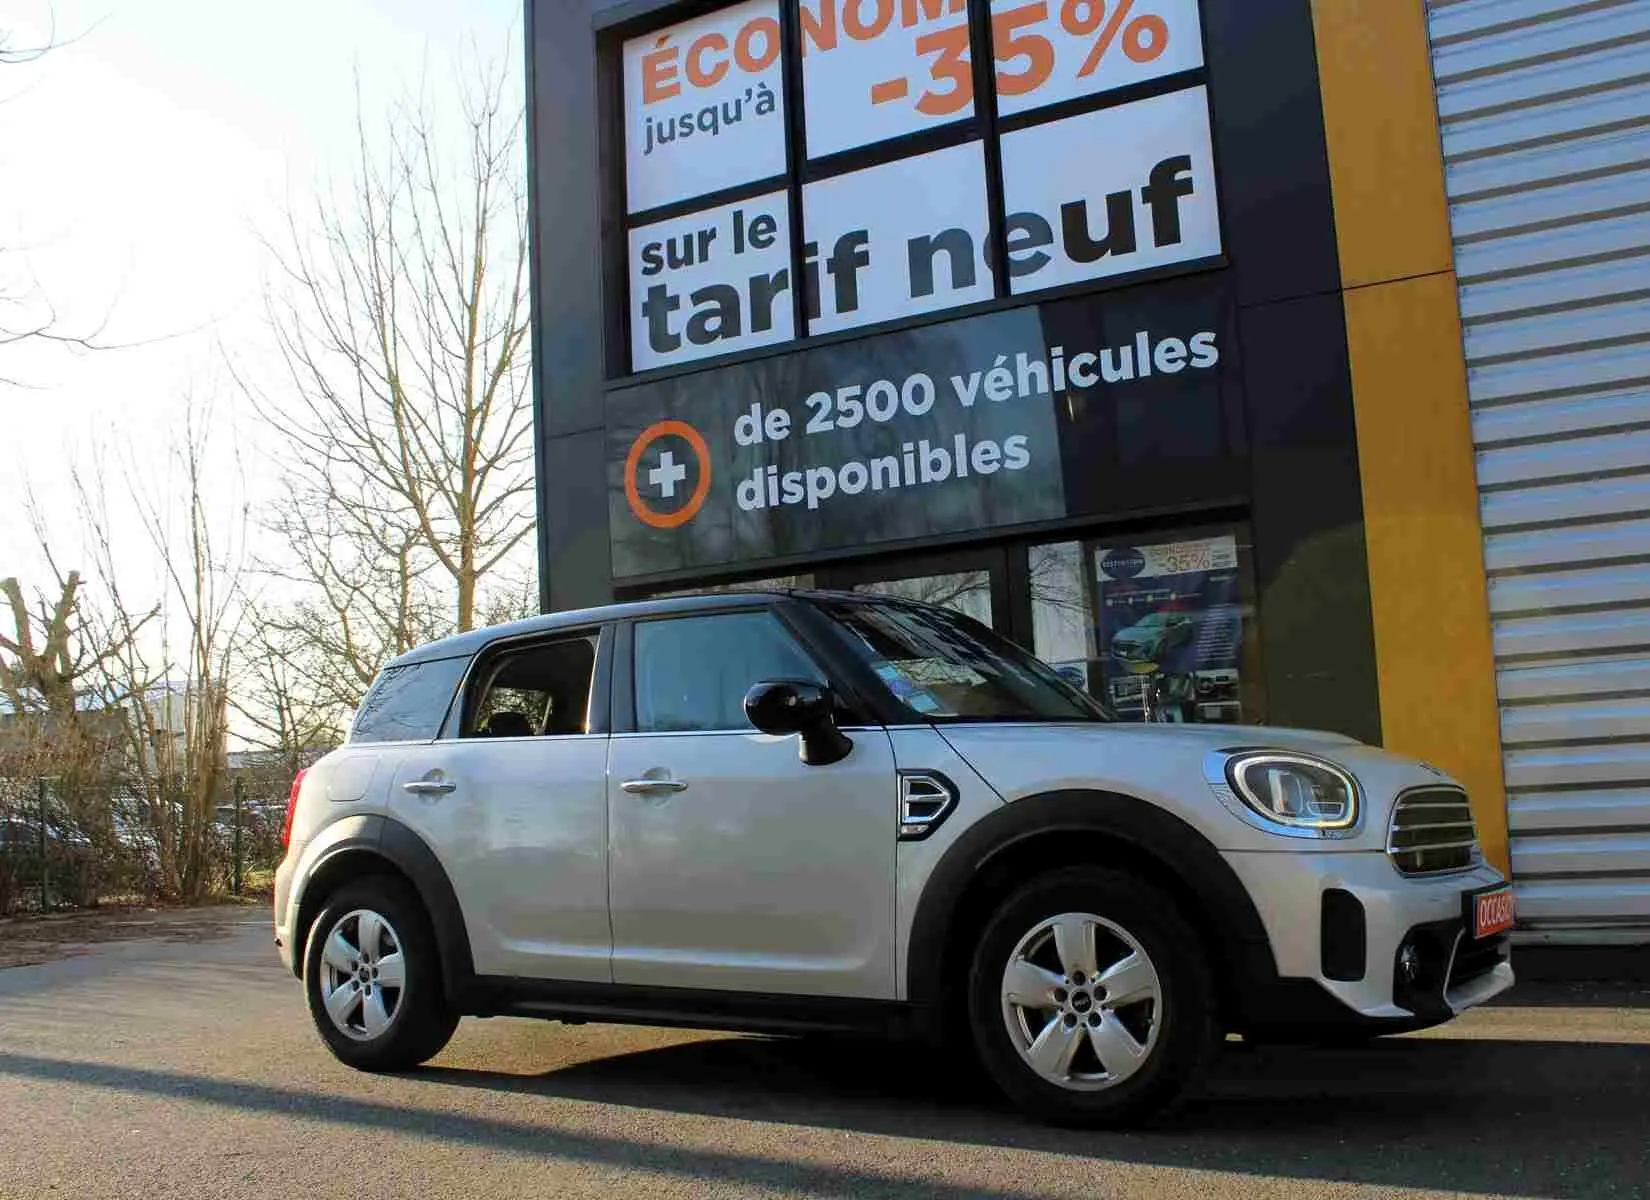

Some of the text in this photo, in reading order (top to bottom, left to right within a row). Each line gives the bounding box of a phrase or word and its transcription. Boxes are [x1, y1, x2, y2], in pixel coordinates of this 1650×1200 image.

[641, 209, 777, 276] sur le
[641, 154, 1194, 353] tarif neuf
[734, 402, 792, 446] de
[806, 373, 936, 435] 2500
[950, 330, 1220, 407] véhicules
[736, 432, 1031, 510] disponibles
